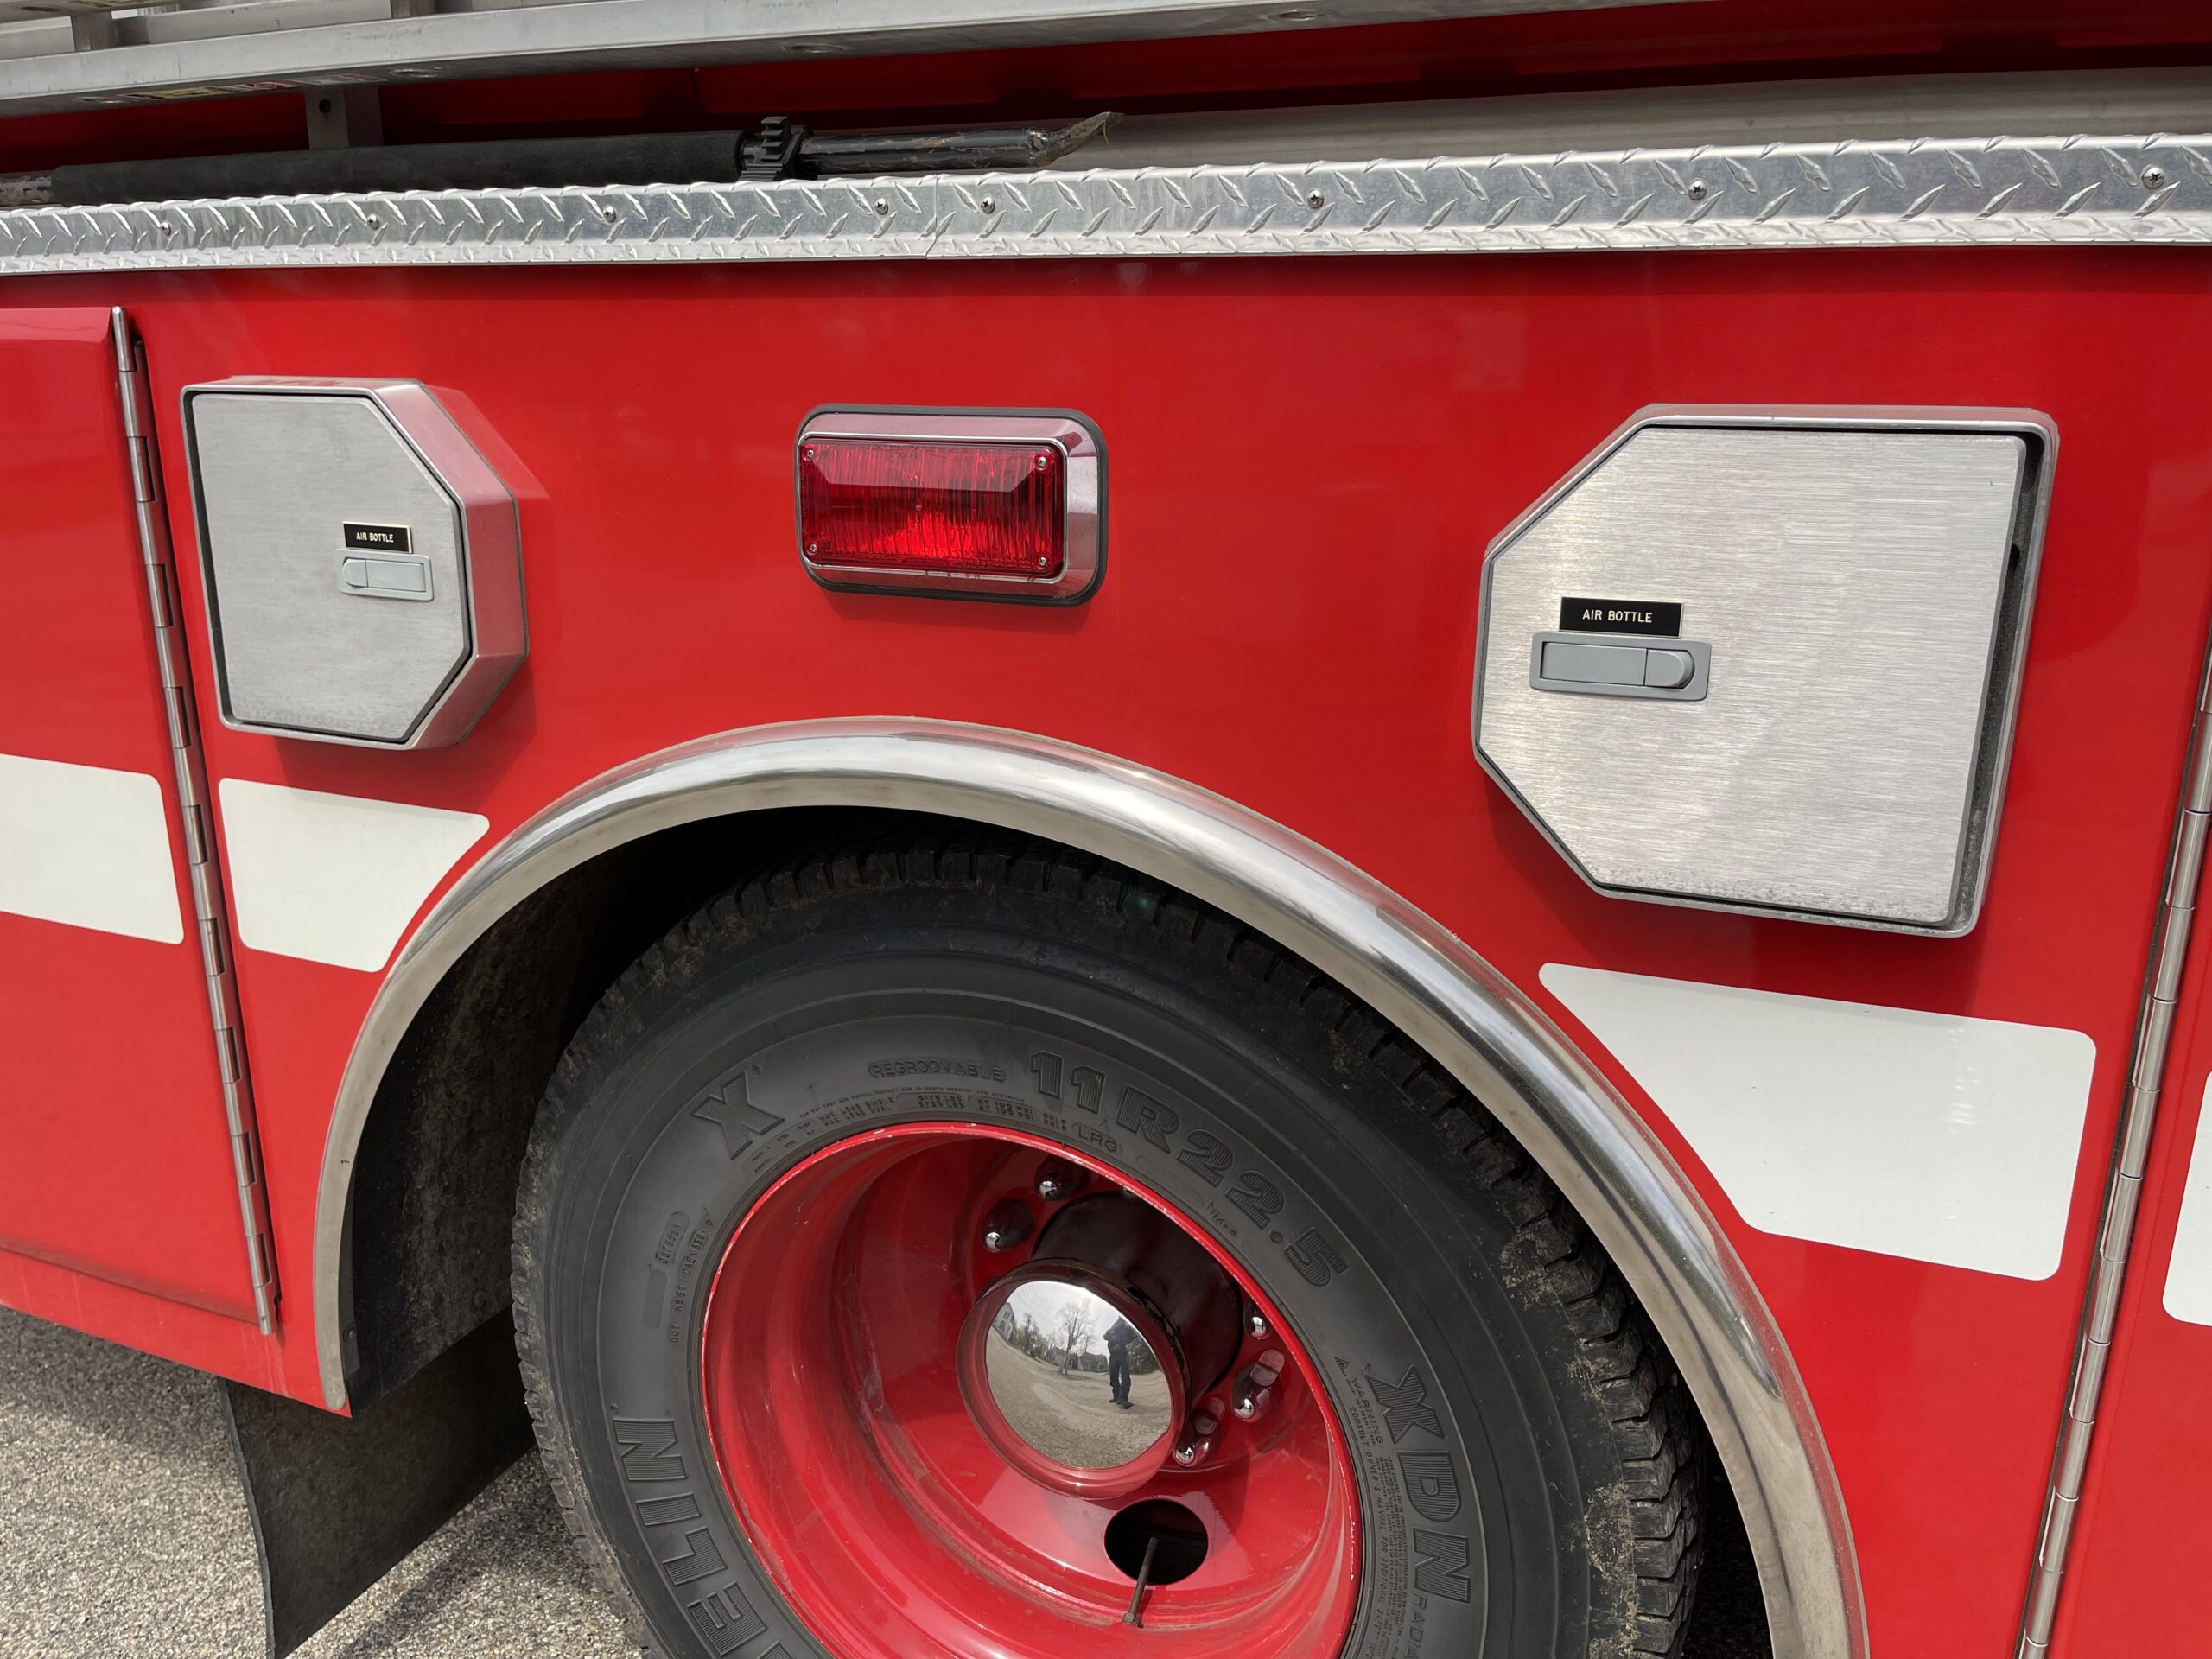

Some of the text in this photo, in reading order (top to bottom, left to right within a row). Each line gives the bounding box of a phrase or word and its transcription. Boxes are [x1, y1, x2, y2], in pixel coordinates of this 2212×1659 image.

[355, 531, 394, 543] AIR BOTTLE
[1581, 608, 1654, 624] AIR BOTTLE
[870, 1057, 1004, 1082] REGROOVABLE
[1077, 1127, 1118, 1154] LRG
[1029, 1049, 1349, 1287] 11R22.5
[1364, 1363, 1471, 1605] XDN
